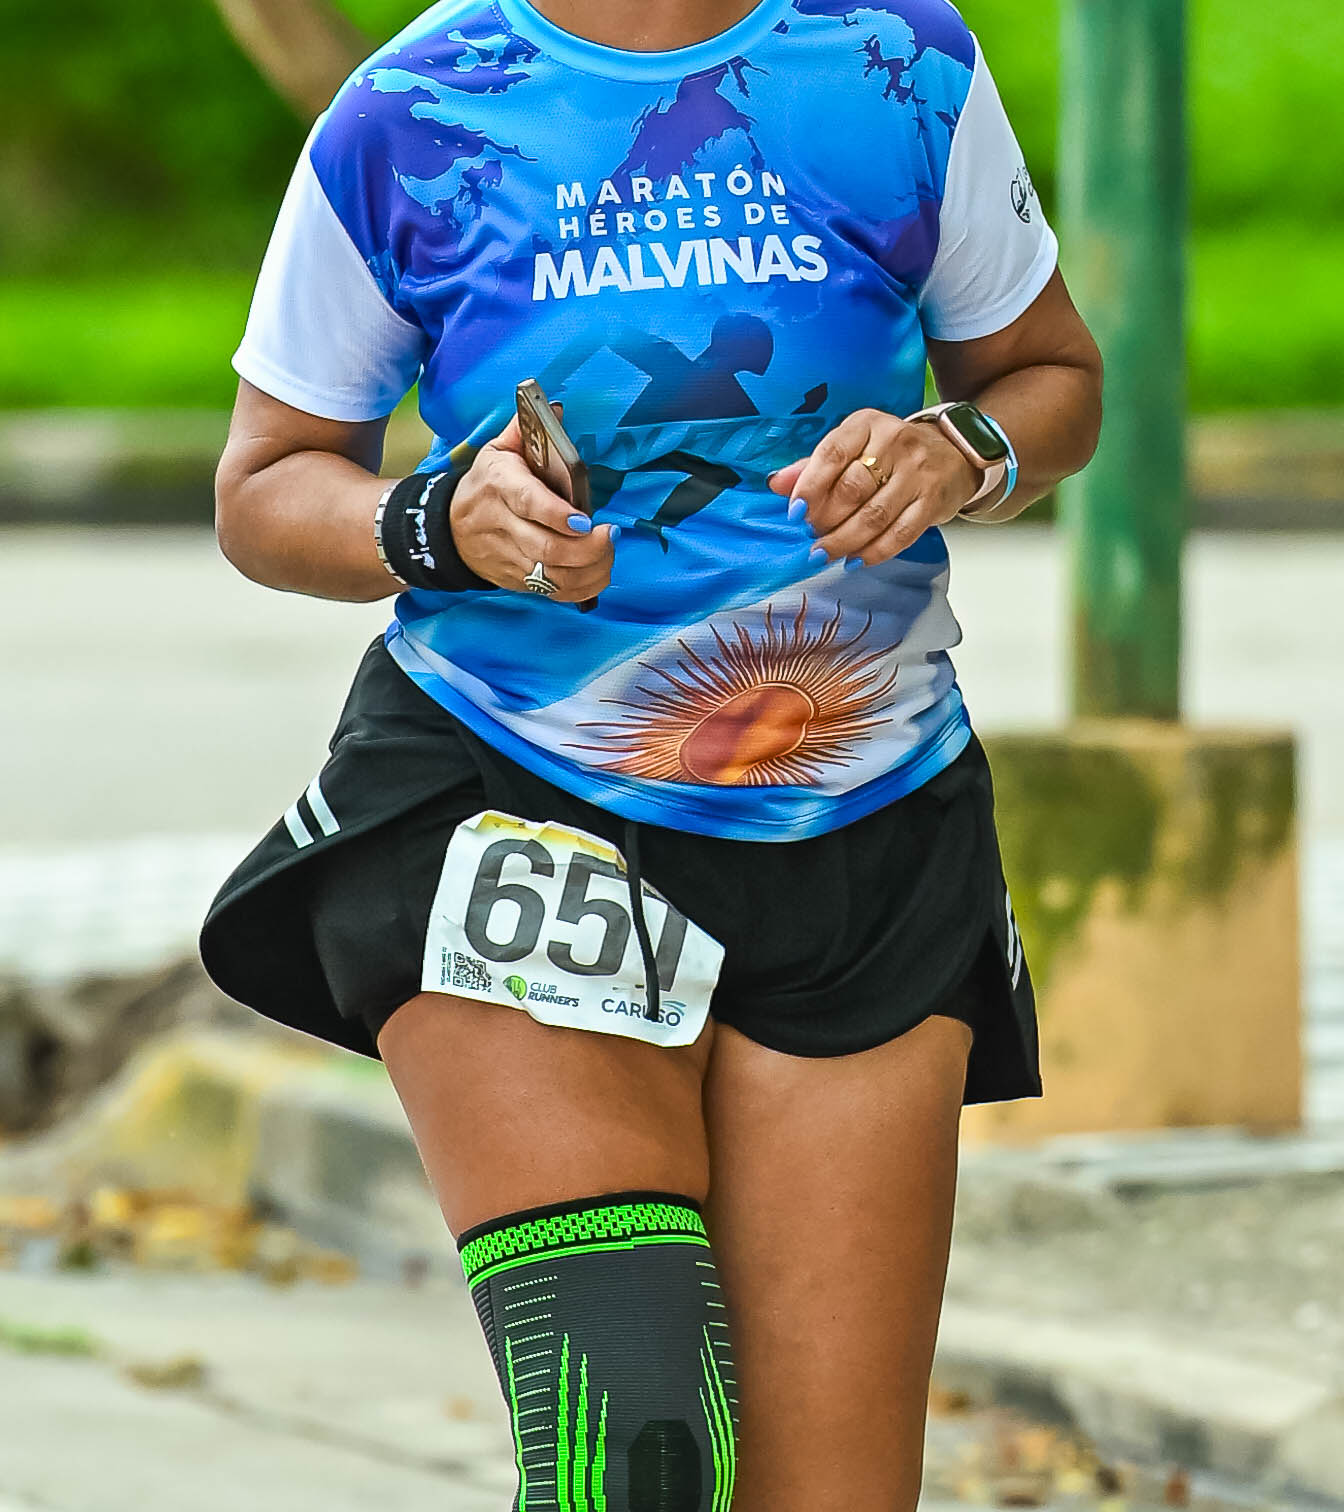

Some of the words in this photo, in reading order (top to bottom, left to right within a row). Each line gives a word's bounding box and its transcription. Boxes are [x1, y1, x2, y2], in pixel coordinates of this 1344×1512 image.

[556, 163, 787, 210] MARATÓN
[559, 204, 722, 239] HÉROES
[745, 203, 790, 226] DE
[532, 234, 829, 301] MALVINAS
[530, 982, 558, 994] CLUB
